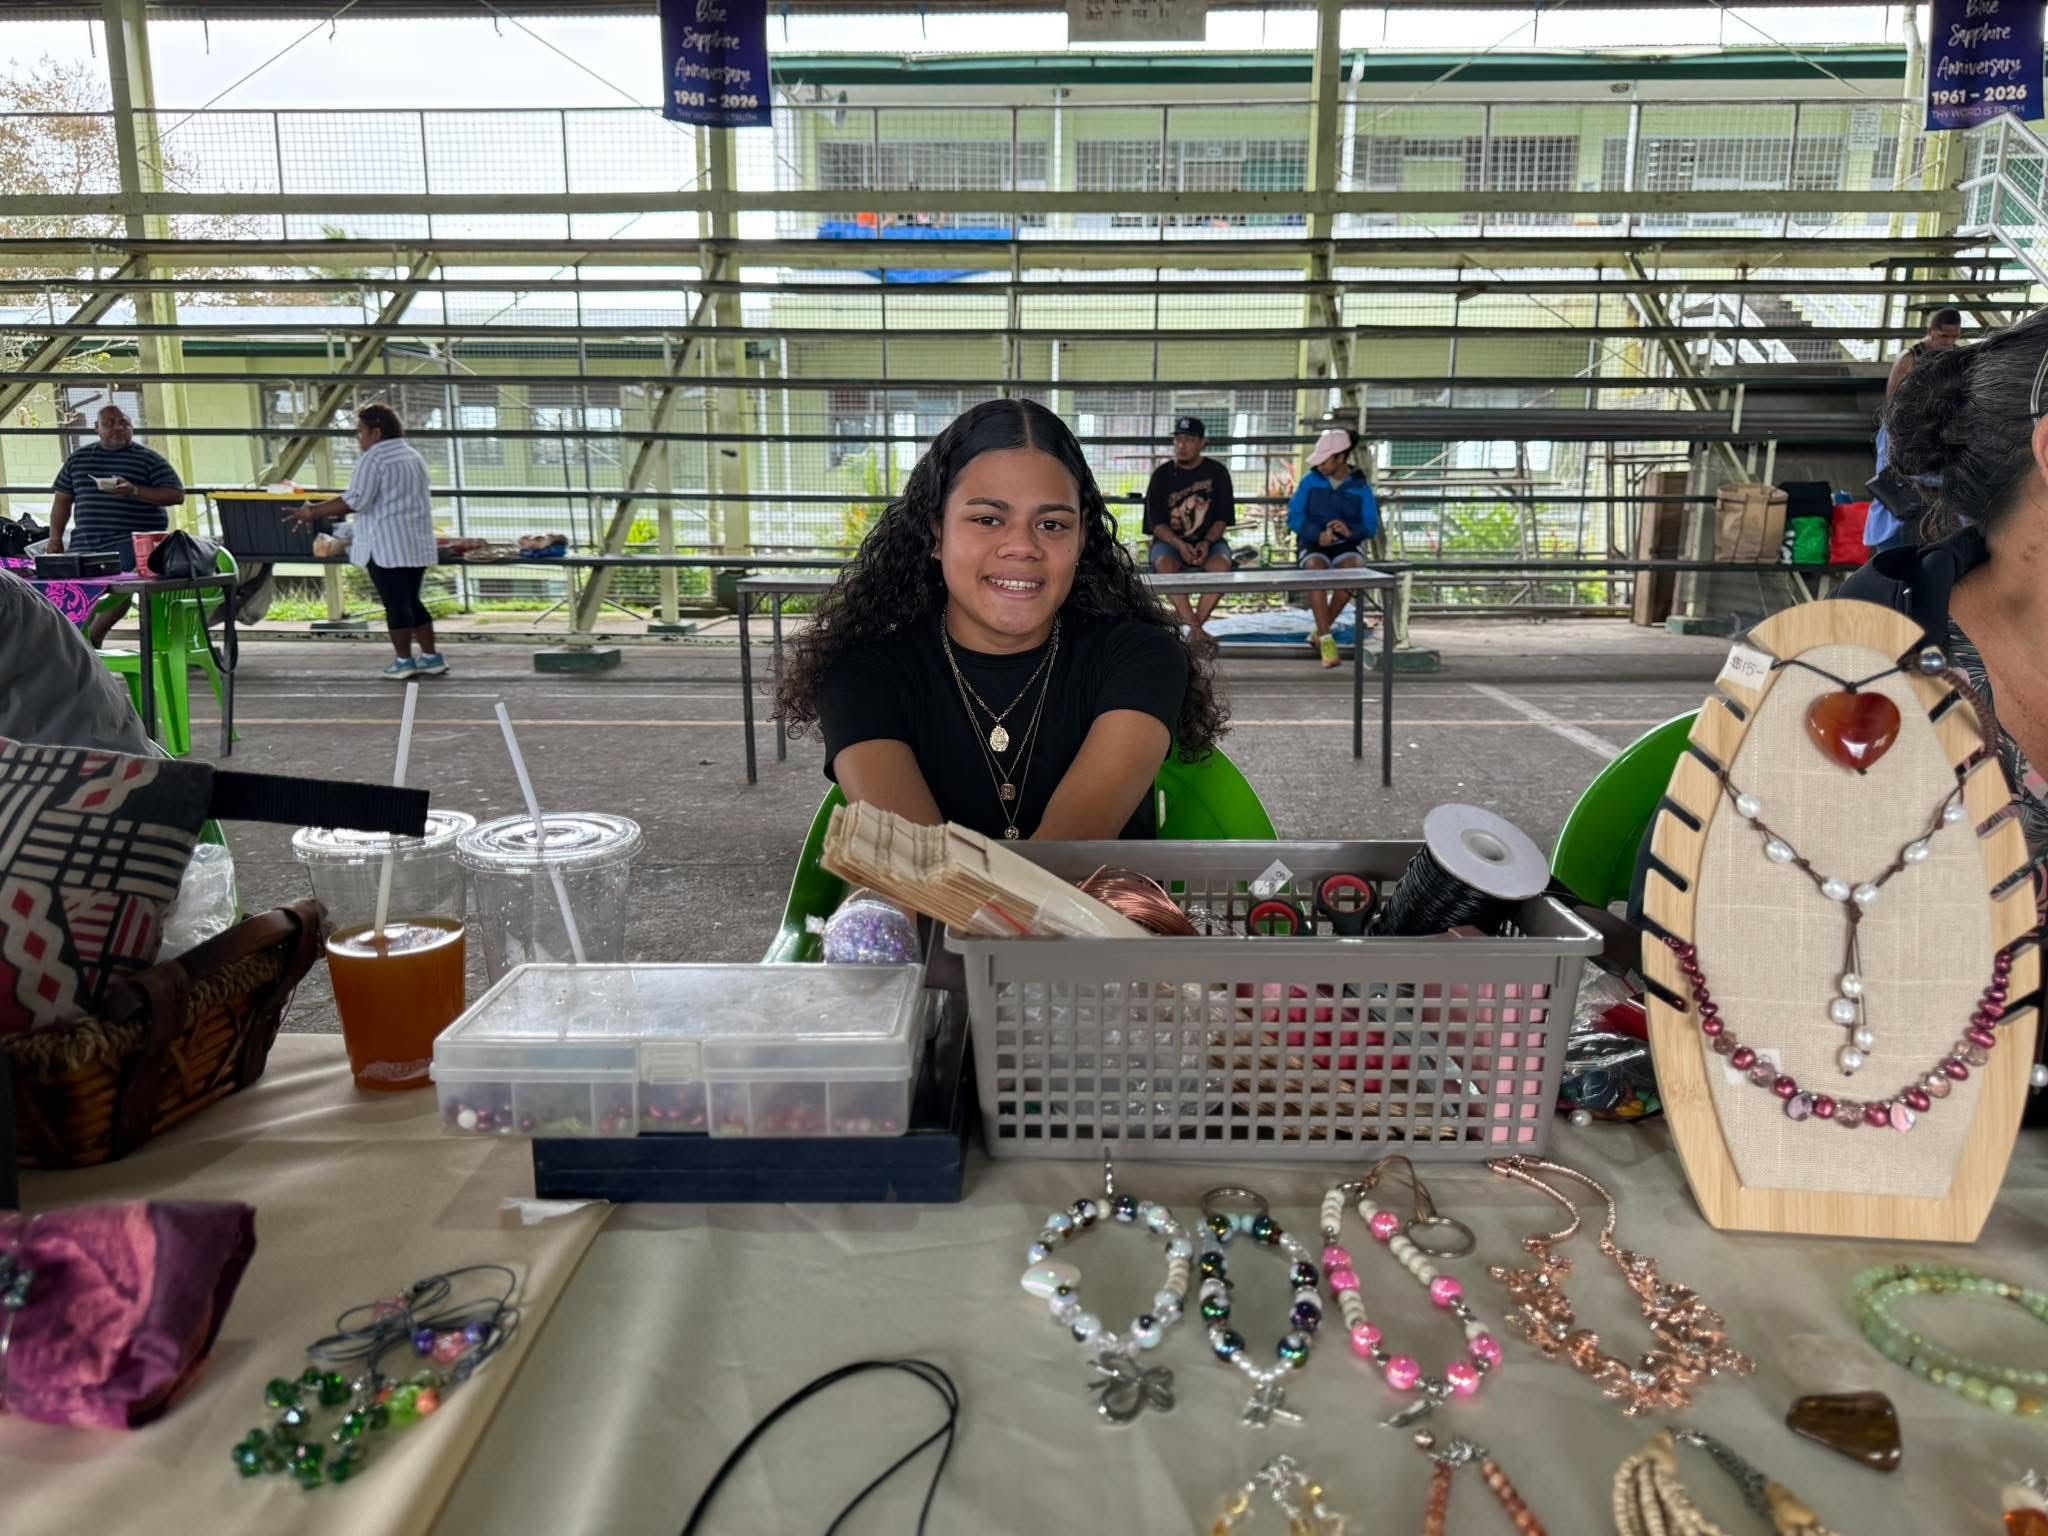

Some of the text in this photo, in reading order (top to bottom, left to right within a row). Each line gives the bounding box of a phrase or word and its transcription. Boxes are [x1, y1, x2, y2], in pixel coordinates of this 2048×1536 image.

[1948, 22, 2012, 48] Sapphire
[1936, 55, 2022, 81] Anniversary
[673, 90, 705, 106] 1961
[721, 94, 759, 109] 2026
[1931, 89, 1967, 105] 1961
[1984, 84, 2028, 102] 2026
[1932, 109, 1949, 119] THY
